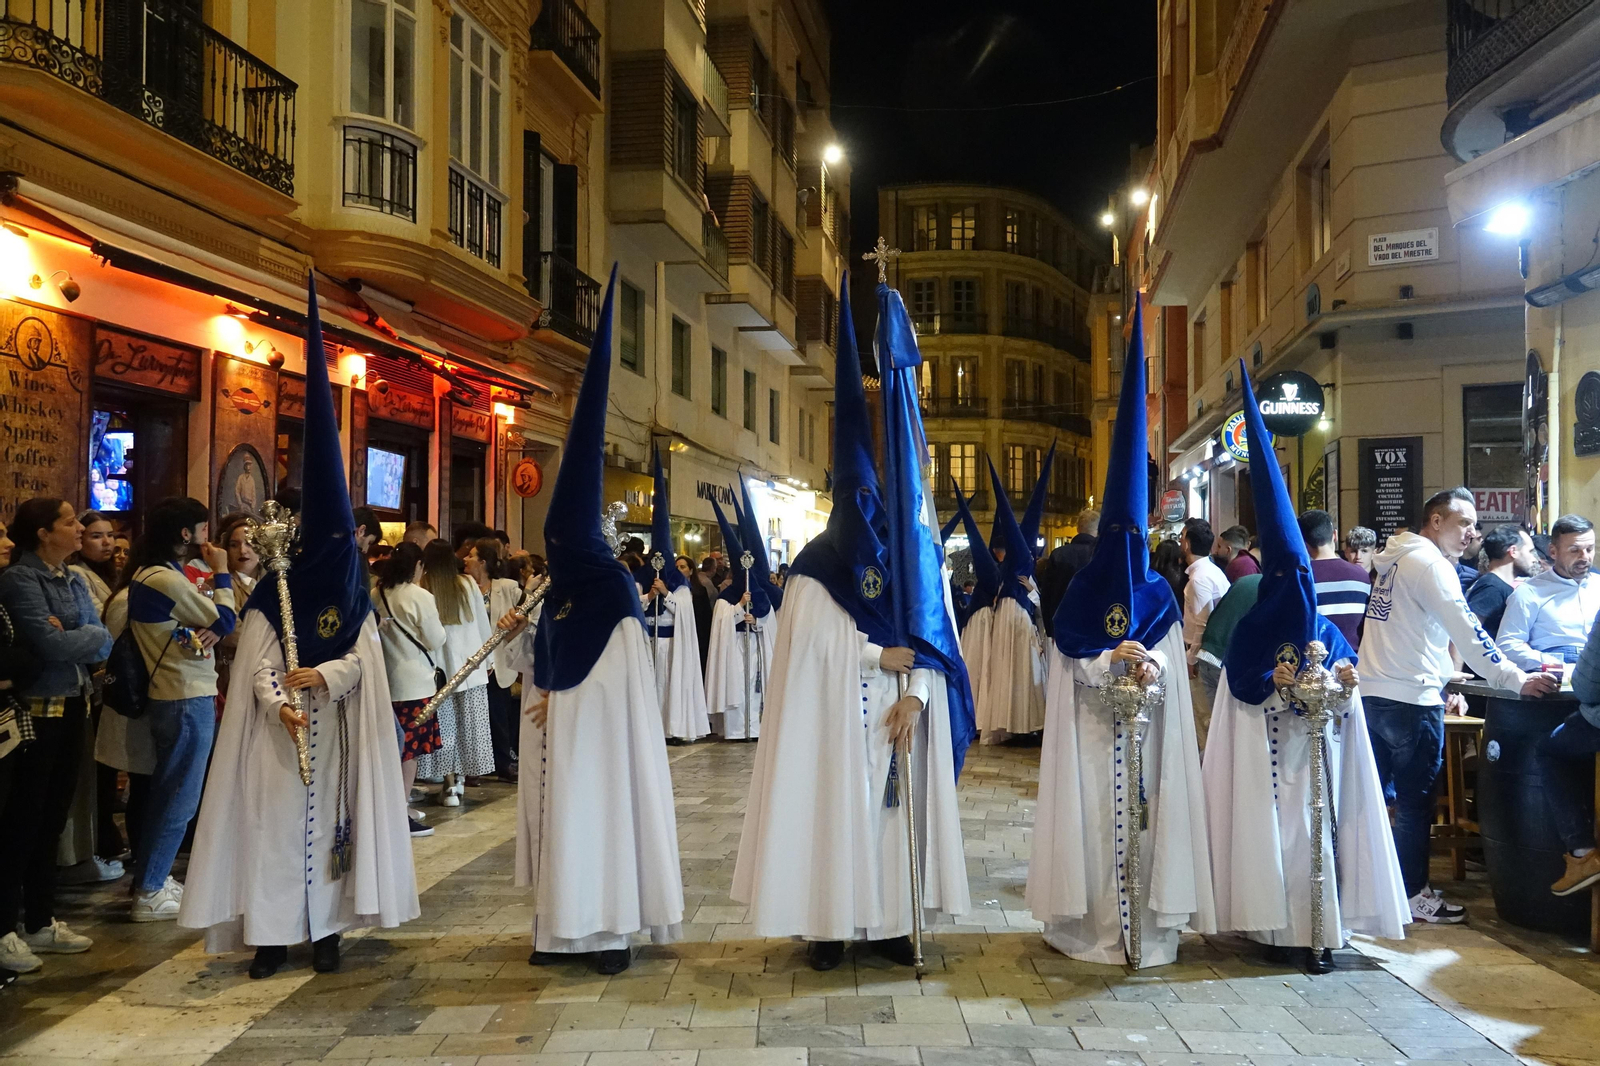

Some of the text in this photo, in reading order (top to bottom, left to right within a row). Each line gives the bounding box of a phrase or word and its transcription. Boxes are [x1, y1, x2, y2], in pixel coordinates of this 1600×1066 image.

[1373, 239, 1428, 253] DEL MARQUÉS DEL
[1373, 247, 1433, 262] VADO DEL MAESTRE
[8, 369, 58, 394] Wines
[1259, 399, 1321, 415] GUINNESS
[3, 420, 60, 445] Spirits
[4, 445, 57, 467] Coffee
[1374, 451, 1407, 464] VOX
[12, 471, 49, 493] Teas
